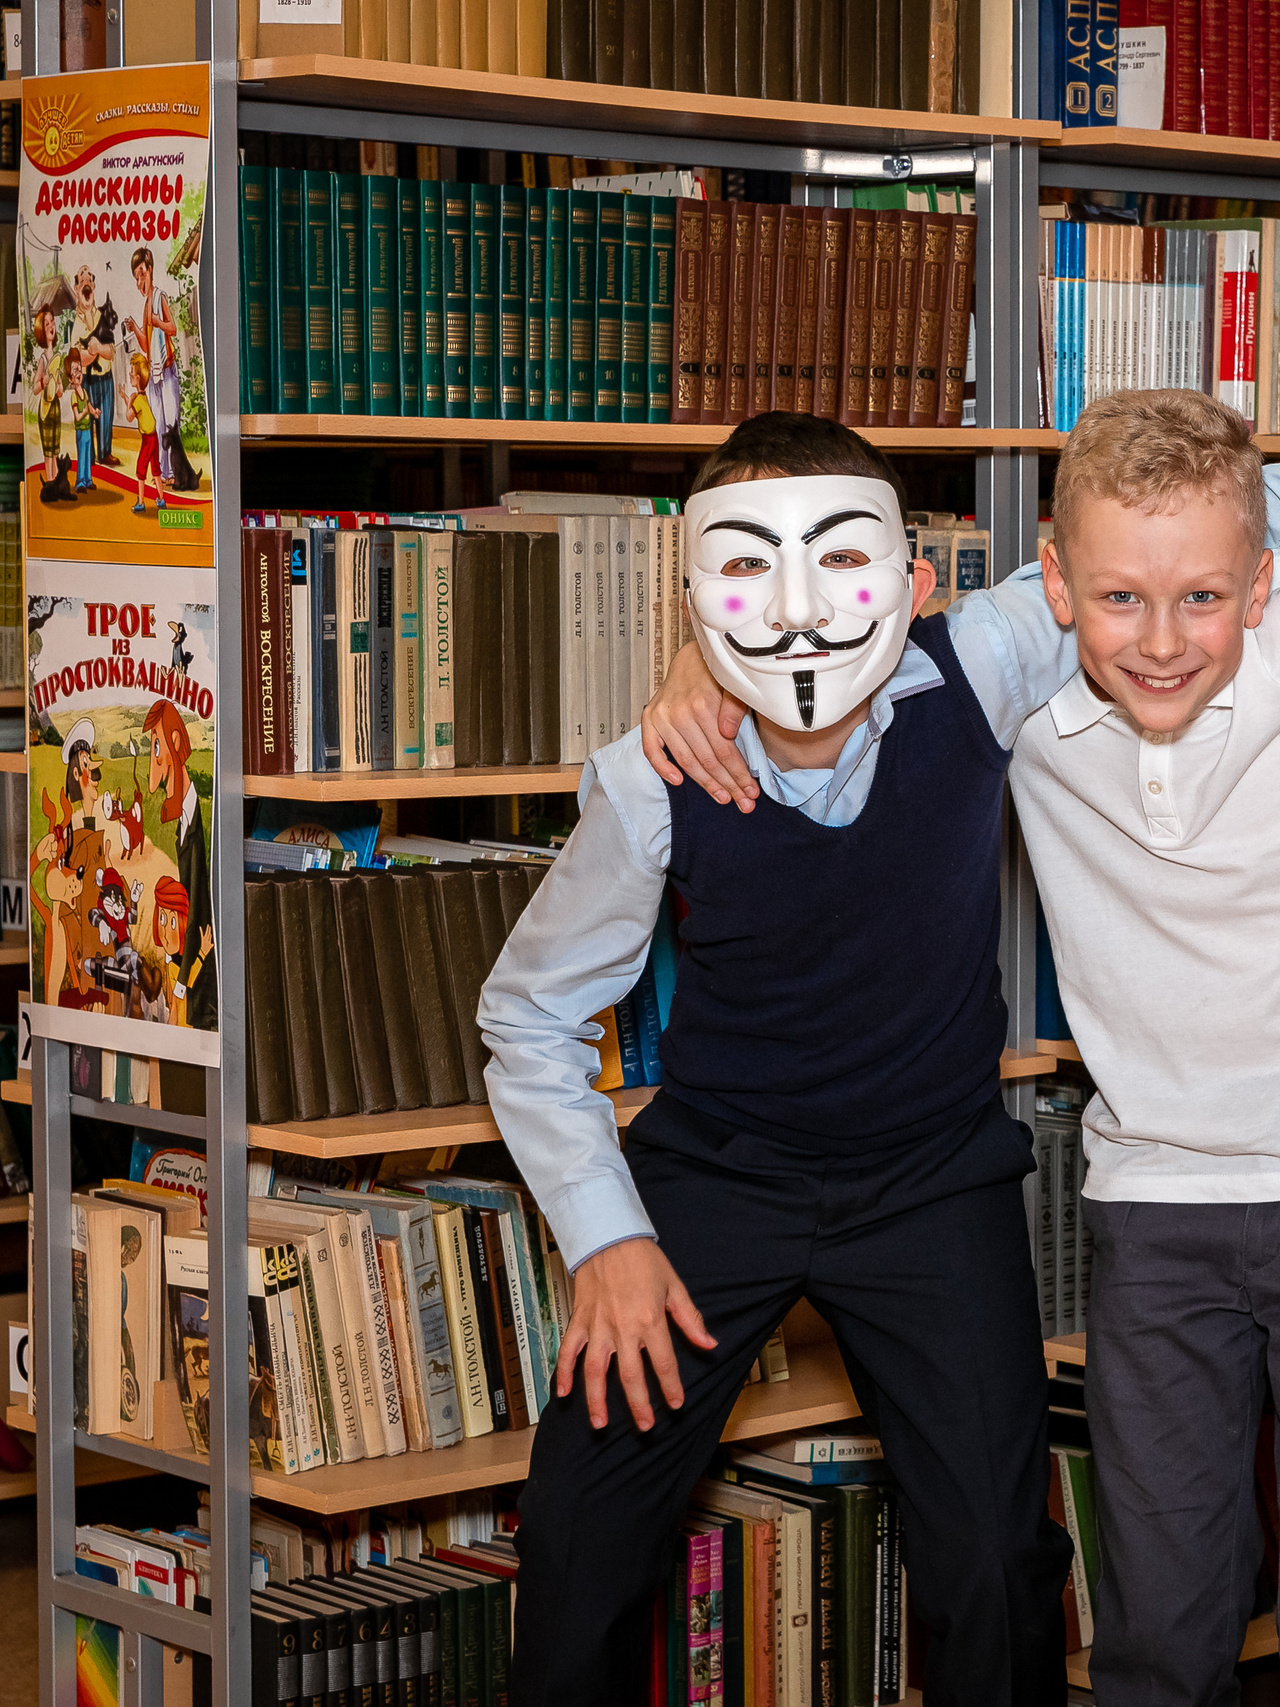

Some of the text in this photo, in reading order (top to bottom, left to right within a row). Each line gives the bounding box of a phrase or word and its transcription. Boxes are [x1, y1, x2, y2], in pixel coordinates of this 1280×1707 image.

[1118, 40, 1147, 49] УШКИН
[1105, 94, 1112, 108] 2
[38, 106, 68, 130] ЛУЧШЕЕ
[61, 129, 85, 150] ДЕТЯМ
[102, 152, 185, 169] ВИКТОР ДРАГУНСКИЙ
[35, 173, 184, 217] ДЕНИСКИНЫ
[57, 208, 181, 245] РАССКАЗЫ
[1245, 291, 1256, 345] Пушкин
[161, 512, 199, 525] ОНИКС
[376, 567, 392, 629] ВОСКРЕСЕНИЕ
[574, 571, 582, 616] ТОЛСТОЙ
[595, 571, 604, 615] ТОЛСТОЙ
[617, 571, 626, 614] ТОЛСТОЙ
[635, 571, 644, 614] ТОЛСТОЙ
[84, 602, 157, 639] ТРОЕ
[283, 550, 293, 674] ВОСКРЕСЕНИЕ
[434, 565, 450, 667] ТОЛСТОЙ
[112, 638, 131, 656] ИЗ
[33, 656, 214, 720] ПРОСТОКВАШИНО
[259, 630, 275, 754] ВОСКРЕСЕНИЕ
[406, 646, 415, 729] ВОСКРЕСЕНИЕ
[576, 723, 583, 736] 1
[599, 722, 606, 734] 2
[619, 722, 626, 734] 2
[287, 827, 331, 849] АЛИСА
[2, 885, 23, 926] М
[155, 1158, 193, 1179] Григорий
[451, 1225, 465, 1279] ПОМЕЩИКА
[458, 1279, 468, 1303] УТРО
[510, 1277, 526, 1352] ХАДЖИ-МУРАТ
[269, 1322, 285, 1411] СМЕРТЬ ИВАНА ИЛЬИЧА
[284, 1385, 293, 1409] Повести
[306, 1374, 316, 1399] Повести
[1060, 1463, 1071, 1503] ЕСЕНИН
[820, 1517, 835, 1590] АРБАТА
[312, 1628, 323, 1650] 8
[359, 1621, 372, 1642] 6
[379, 1619, 391, 1638] 4
[405, 1613, 417, 1634] 3
[283, 1634, 296, 1655] 9
